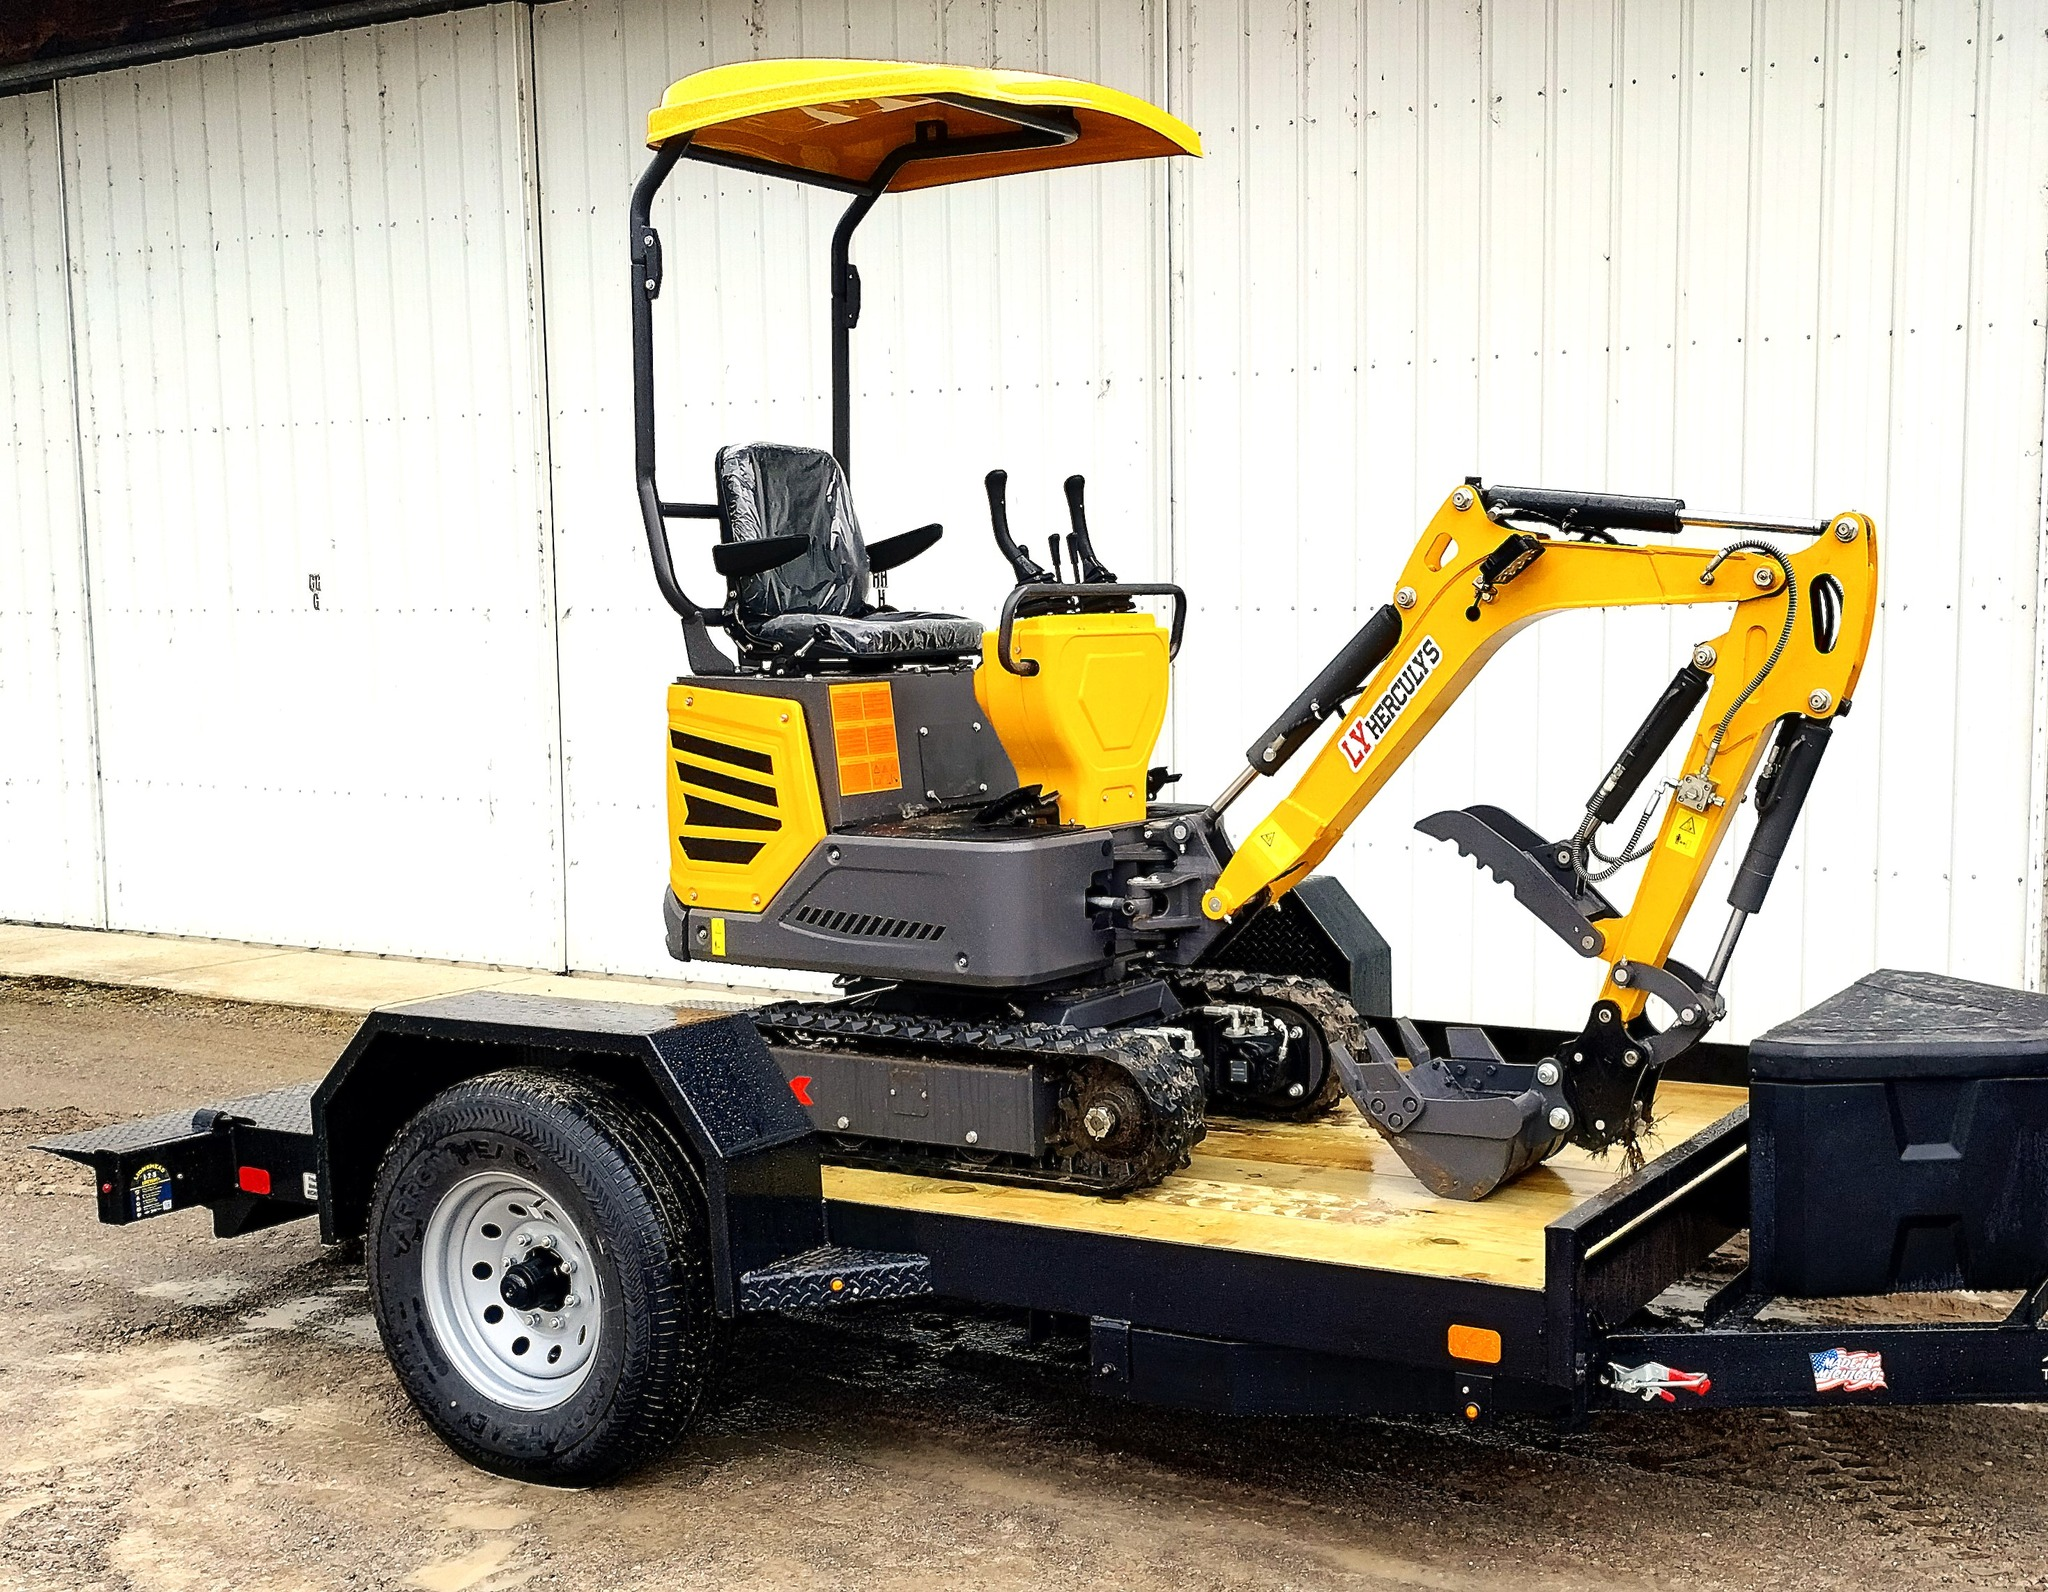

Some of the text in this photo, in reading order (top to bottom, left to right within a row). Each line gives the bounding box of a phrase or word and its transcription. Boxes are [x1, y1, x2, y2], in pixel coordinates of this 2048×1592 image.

[1341, 638, 1440, 768] LY HERCULYS
[1823, 1357, 1876, 1369] MADE IN
[1816, 1368, 1881, 1380] MICHIGAN
